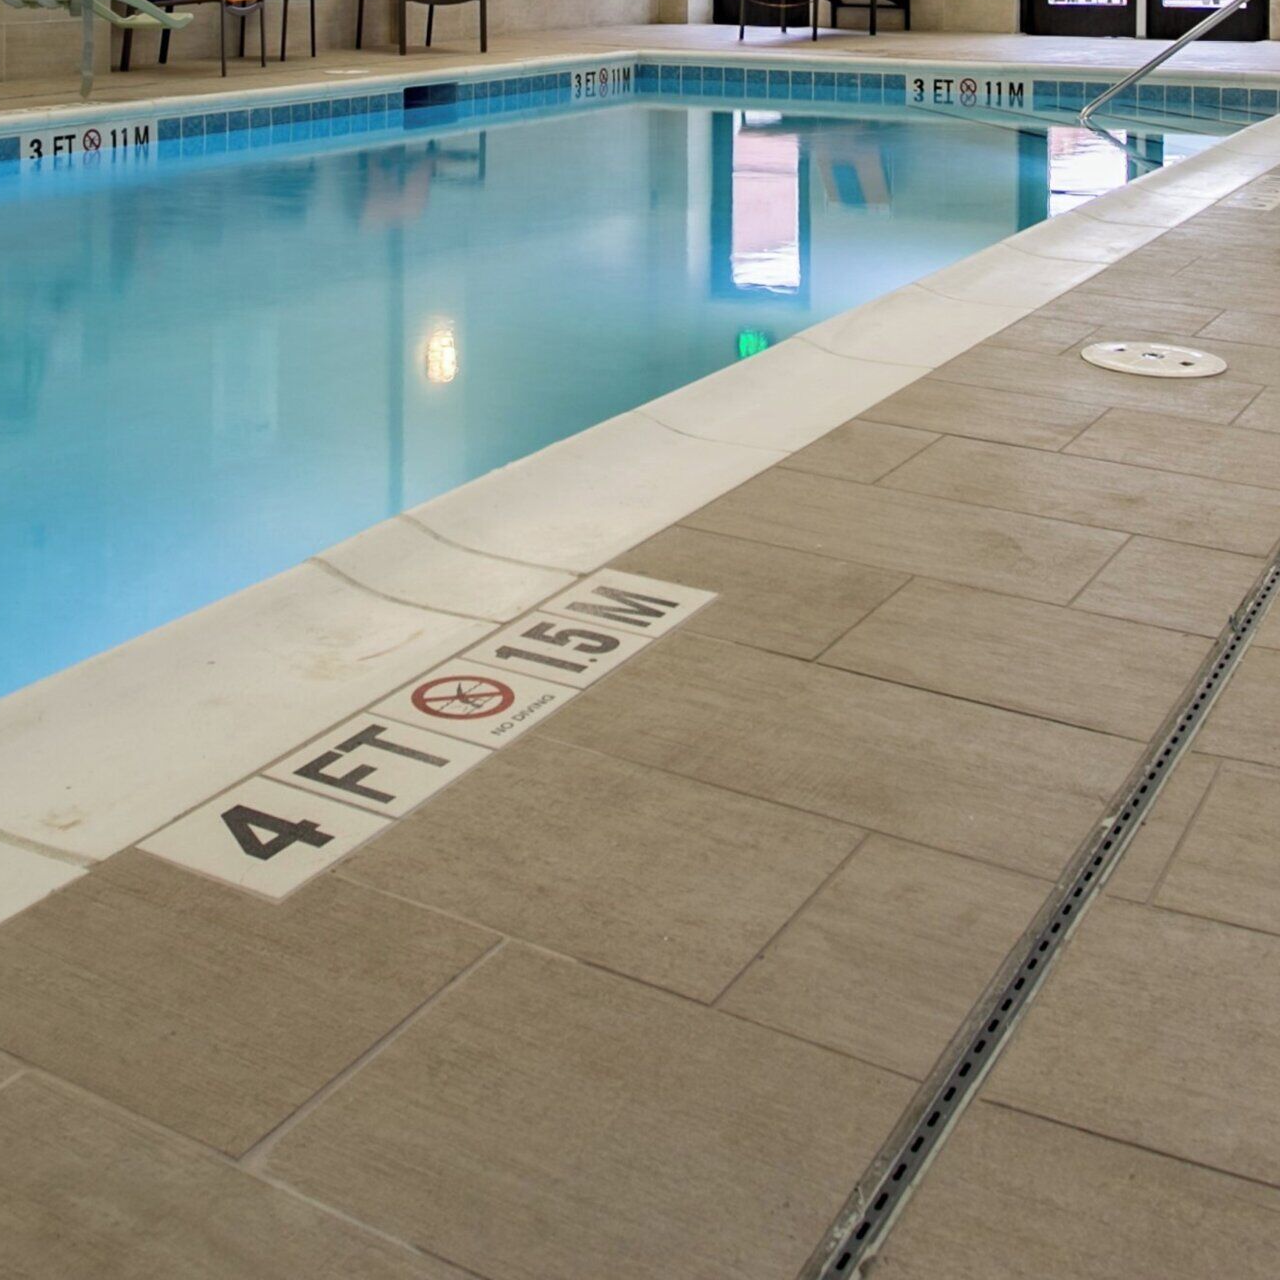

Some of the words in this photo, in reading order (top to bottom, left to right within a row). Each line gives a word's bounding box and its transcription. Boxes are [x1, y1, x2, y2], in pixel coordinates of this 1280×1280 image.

[913, 78, 924, 93] 3
[1009, 82, 1024, 96] M
[29, 138, 43, 159] 3
[53, 134, 76, 156] FT
[134, 125, 150, 146] M
[220, 803, 336, 861] 4
[292, 723, 451, 805] FT
[563, 585, 680, 629] M
[490, 721, 515, 737] NO
[511, 694, 556, 722] DIVING
